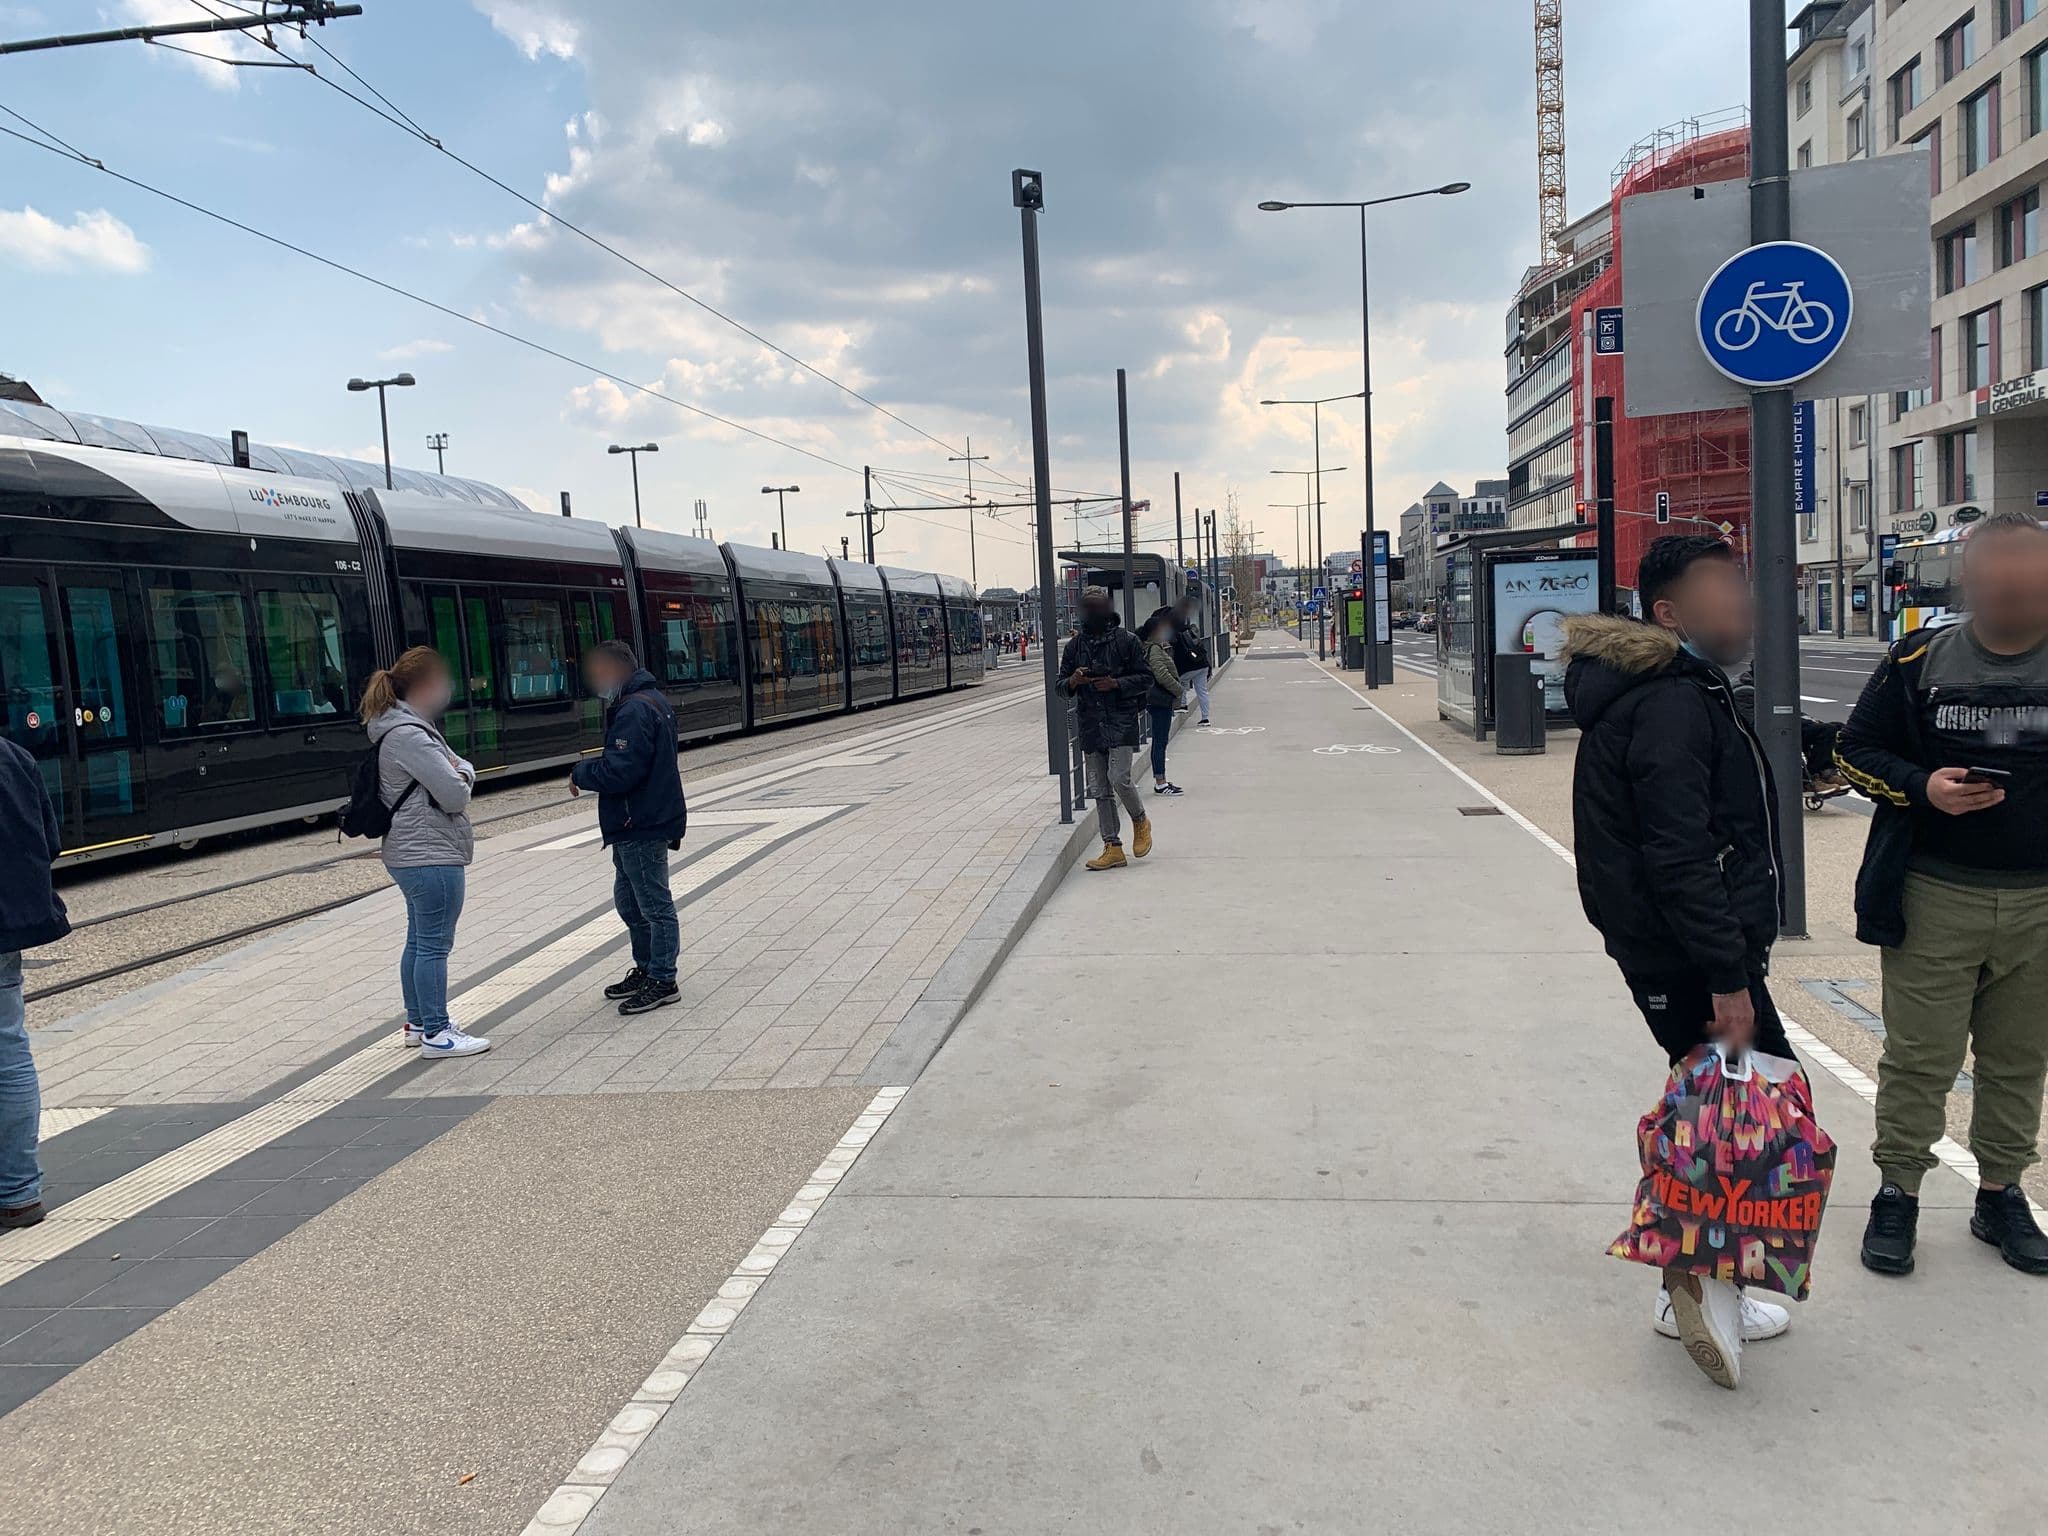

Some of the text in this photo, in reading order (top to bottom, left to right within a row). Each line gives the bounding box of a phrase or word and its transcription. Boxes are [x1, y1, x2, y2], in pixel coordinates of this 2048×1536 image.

[1992, 373, 2036, 397] SOCIETE
[1992, 386, 2047, 412] GENERALE
[1793, 407, 1804, 511] EMPIRE HOTEL
[249, 488, 331, 510] LUXEMBOURG
[1892, 518, 1921, 533] BÄCKERE
